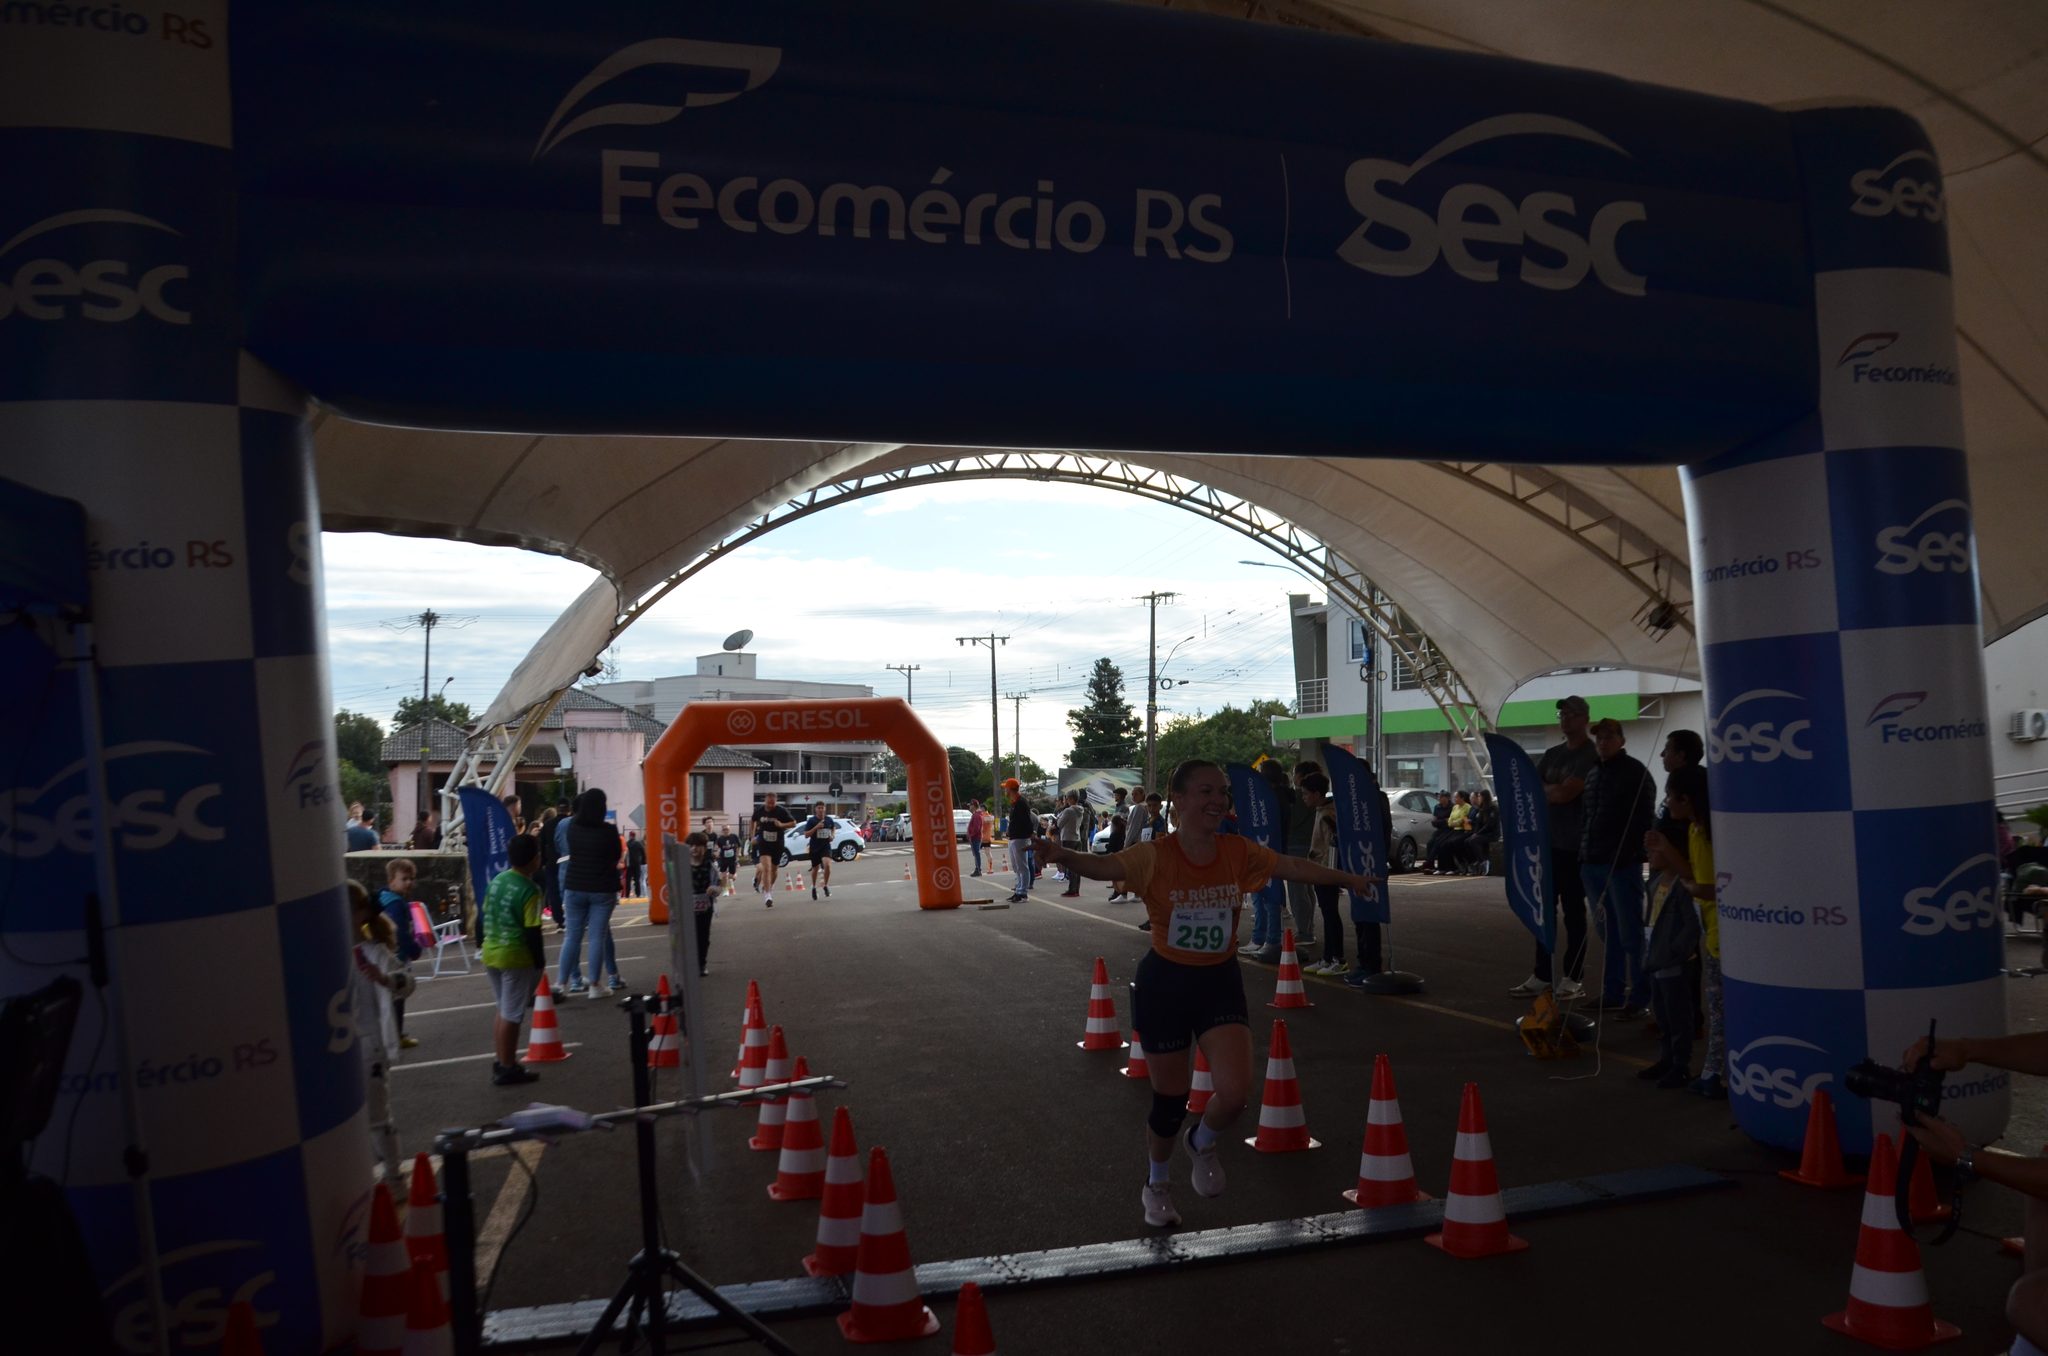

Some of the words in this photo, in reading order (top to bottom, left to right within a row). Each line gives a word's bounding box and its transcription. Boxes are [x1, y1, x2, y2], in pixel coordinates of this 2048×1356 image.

[161, 12, 213, 50] RS
[601, 148, 1106, 254] Fecomércio
[1132, 187, 1235, 264] RS
[1335, 156, 1648, 297] Sesc
[0, 256, 193, 326] esc
[185, 539, 234, 569] RS
[1787, 548, 1822, 571] RS
[764, 708, 870, 732] CRESOL
[926, 772, 950, 860] CRESOL
[1717, 902, 1805, 926] ecomércio
[1813, 905, 1849, 926] RS
[1176, 925, 1224, 950] 259
[232, 1037, 279, 1073] RS
